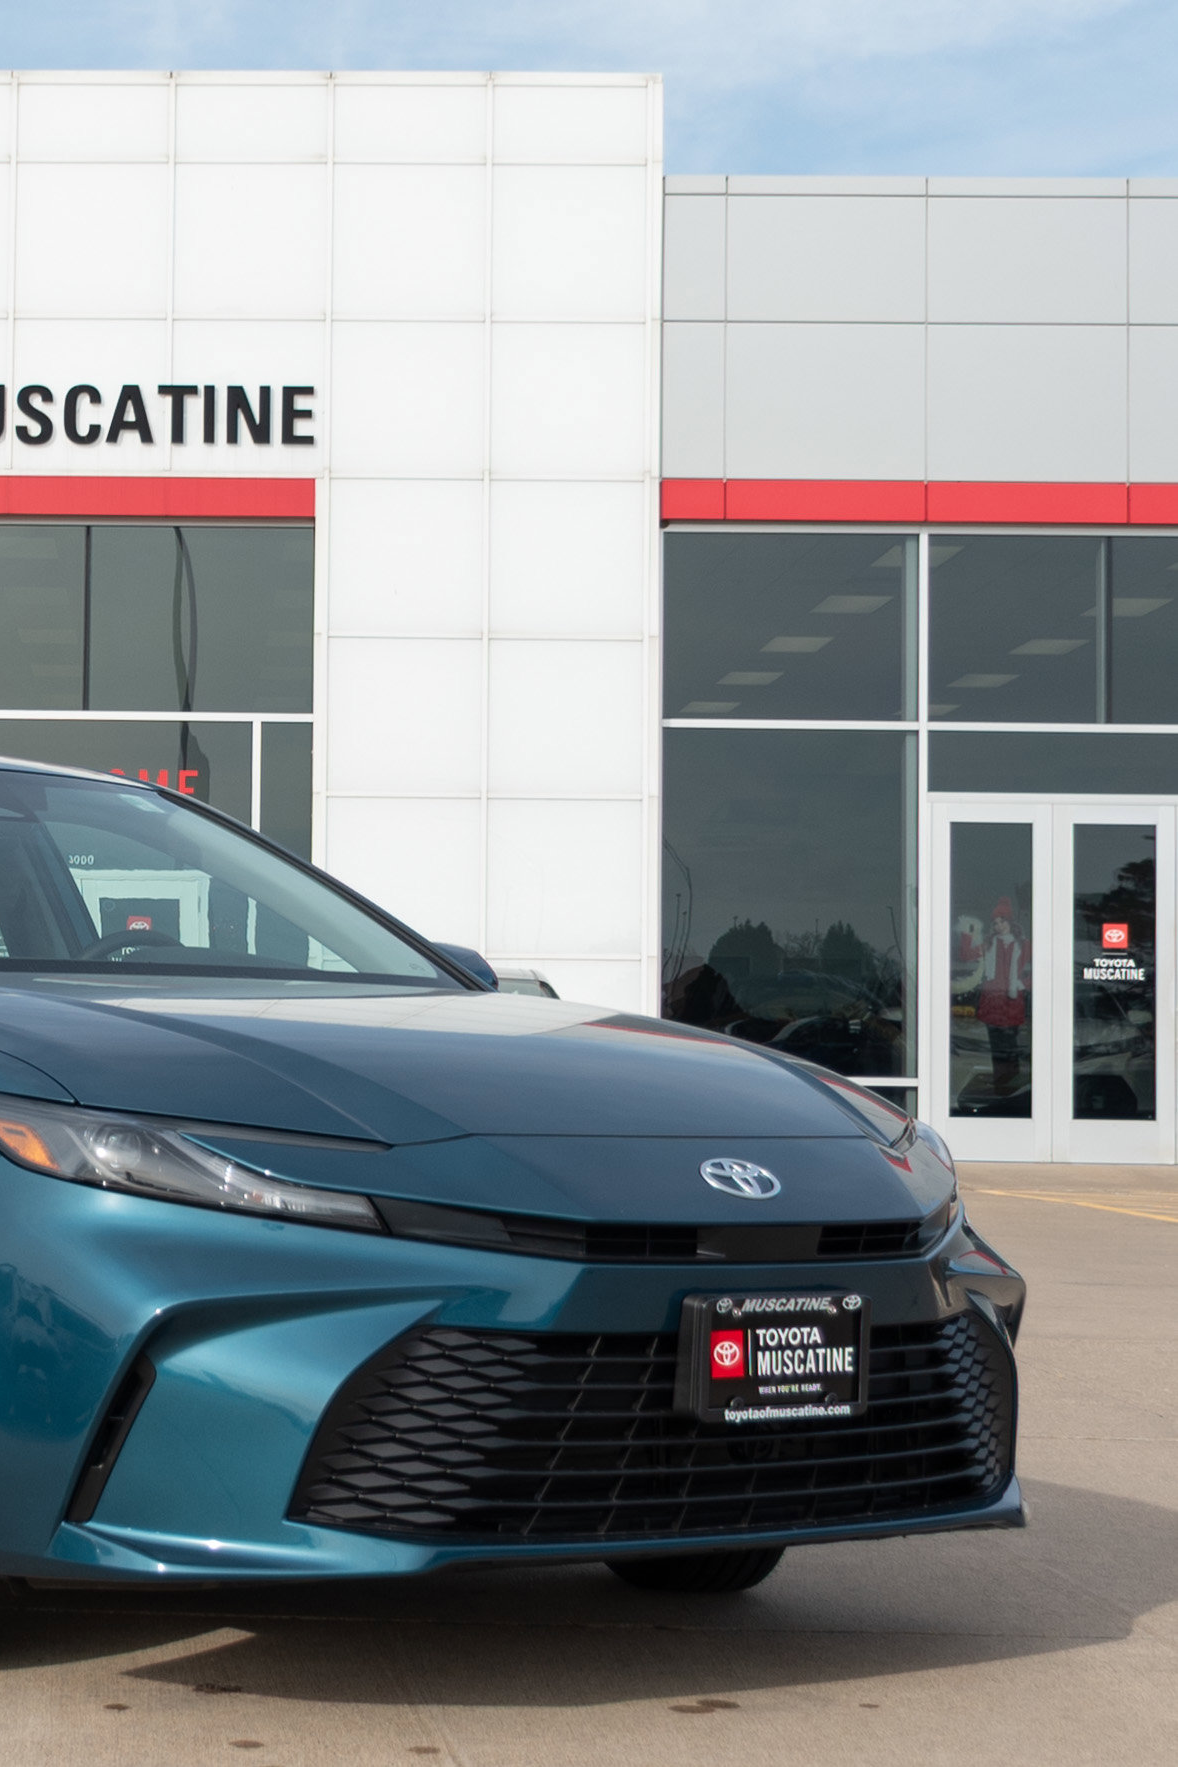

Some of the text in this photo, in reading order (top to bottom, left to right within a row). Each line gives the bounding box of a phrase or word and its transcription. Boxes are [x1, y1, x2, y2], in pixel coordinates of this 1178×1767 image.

[1093, 958, 1136, 968] TOYOTA
[1083, 968, 1146, 981] MUSCATINE
[741, 1297, 832, 1313] MUSCATINE
[755, 1326, 822, 1347] TOYOTA
[757, 1346, 854, 1377] MUSCATINE
[724, 1404, 851, 1422] toyotaofmuscatine.com
